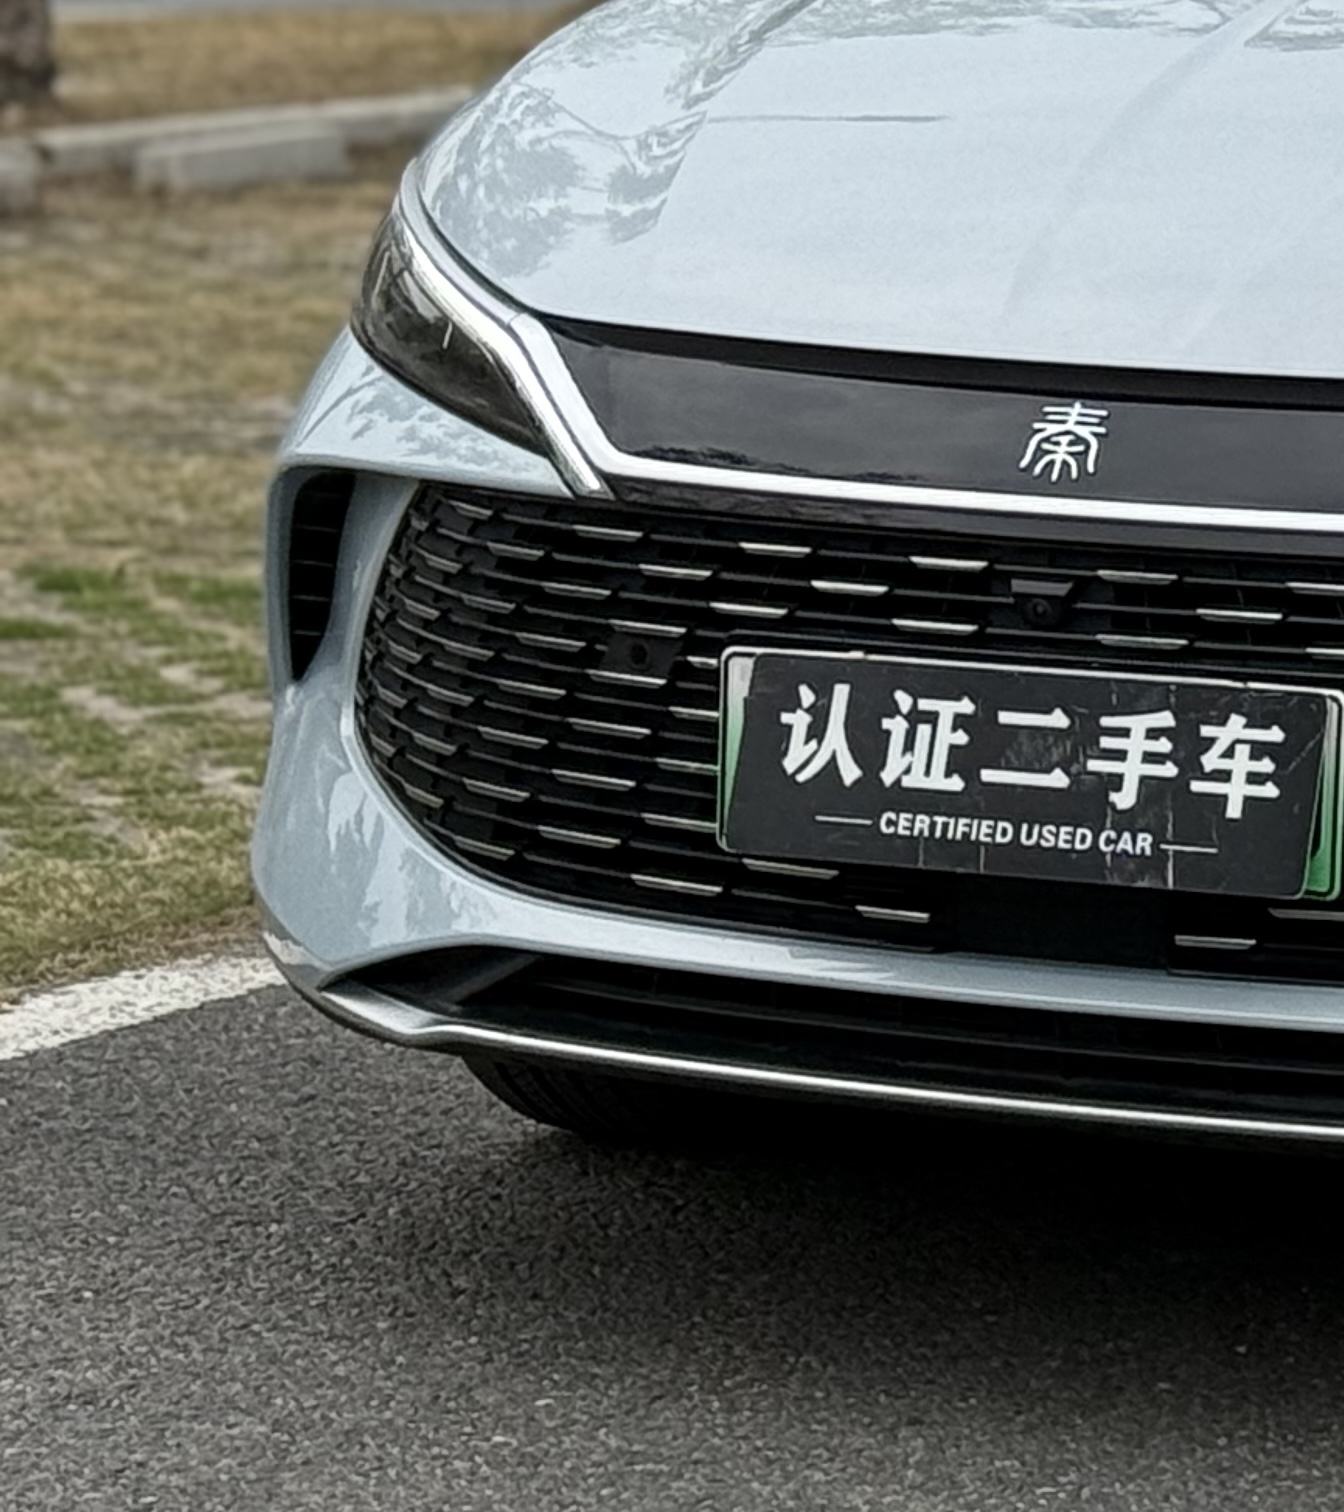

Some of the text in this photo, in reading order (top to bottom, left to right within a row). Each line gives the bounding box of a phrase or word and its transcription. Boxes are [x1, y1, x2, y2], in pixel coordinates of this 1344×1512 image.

[1019, 401, 1108, 482] 秦
[780, 683, 1286, 819] 认证二手车
[879, 811, 1154, 856] CERTIFIED USED CAR
